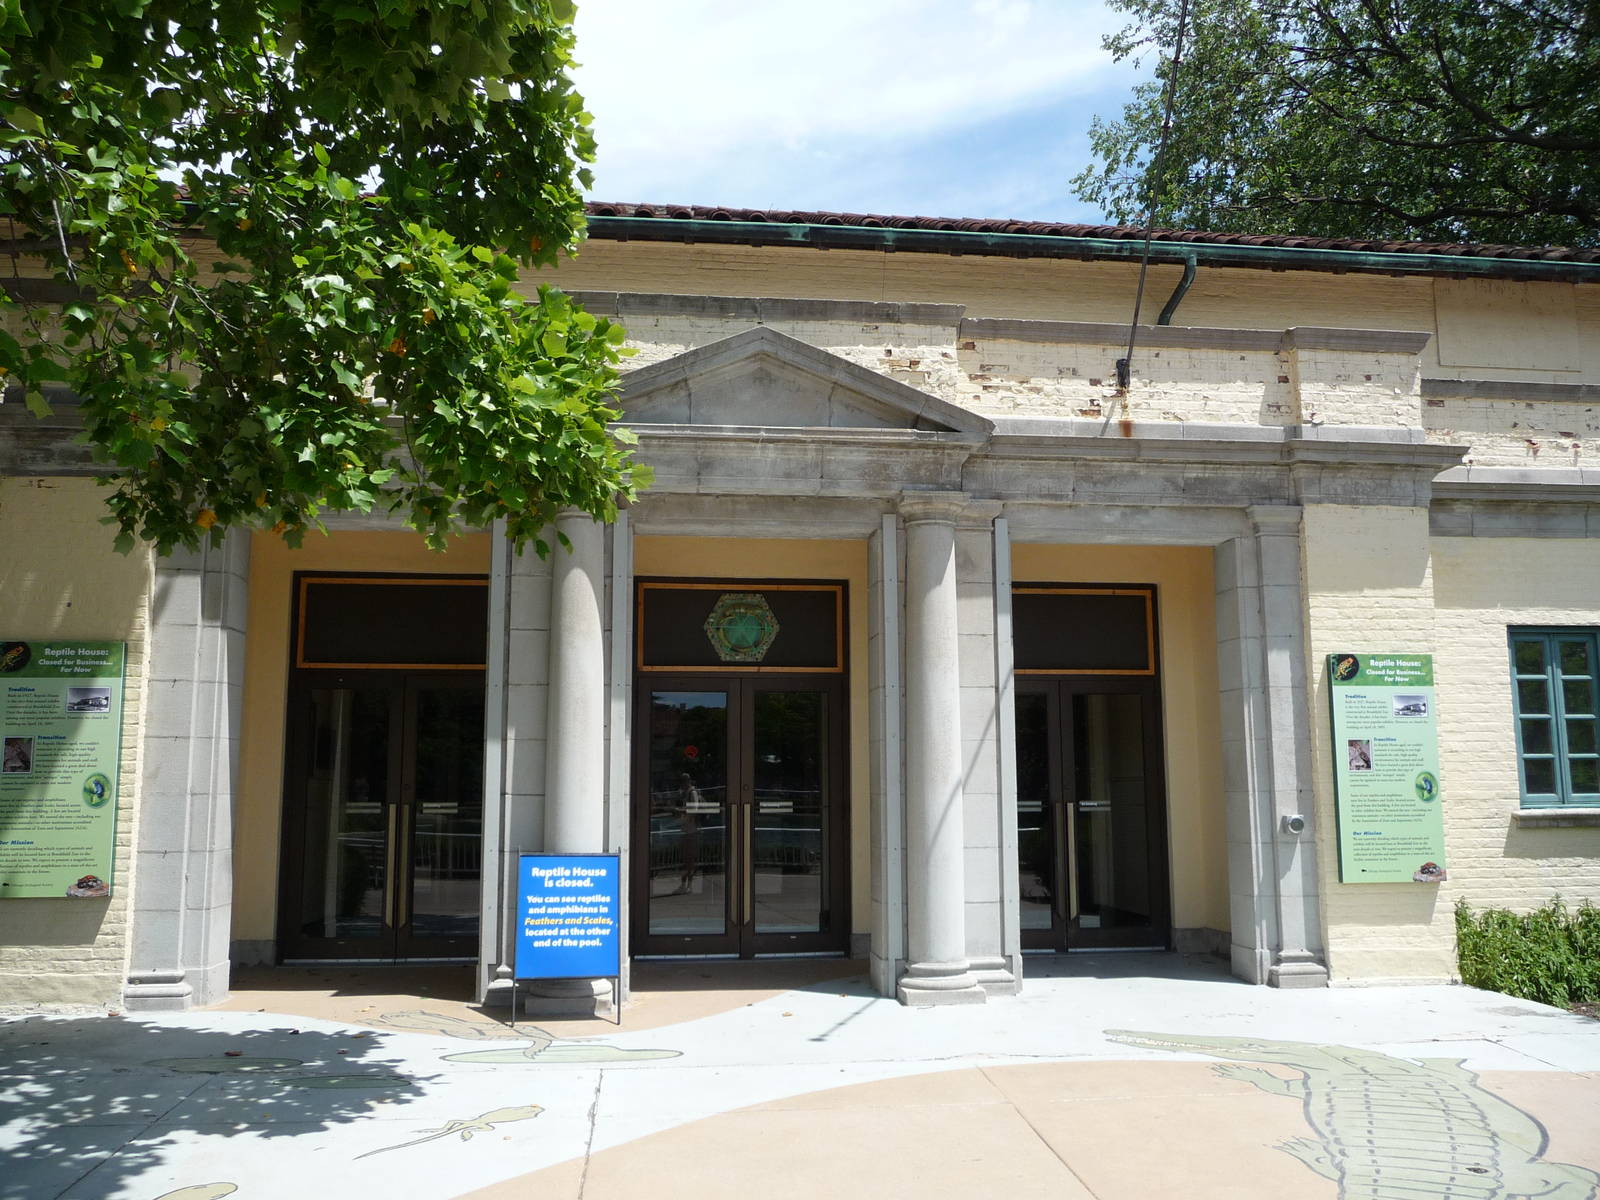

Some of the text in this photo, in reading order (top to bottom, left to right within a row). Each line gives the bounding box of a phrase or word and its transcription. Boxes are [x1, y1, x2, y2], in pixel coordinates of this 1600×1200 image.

[45, 648, 109, 657] Reptile House:
[1370, 659, 1421, 668] Reptile House:
[531, 867, 607, 878] Reptile House
[544, 877, 594, 887] is closed.
[527, 895, 543, 903] You
[577, 894, 611, 904] reptiles
[528, 905, 609, 915] and amphibians in
[524, 916, 613, 925] Feathers and Scales,
[525, 927, 558, 936] located
[570, 927, 585, 935] the
[586, 927, 611, 935] other
[533, 938, 602, 948] end of the pool.
